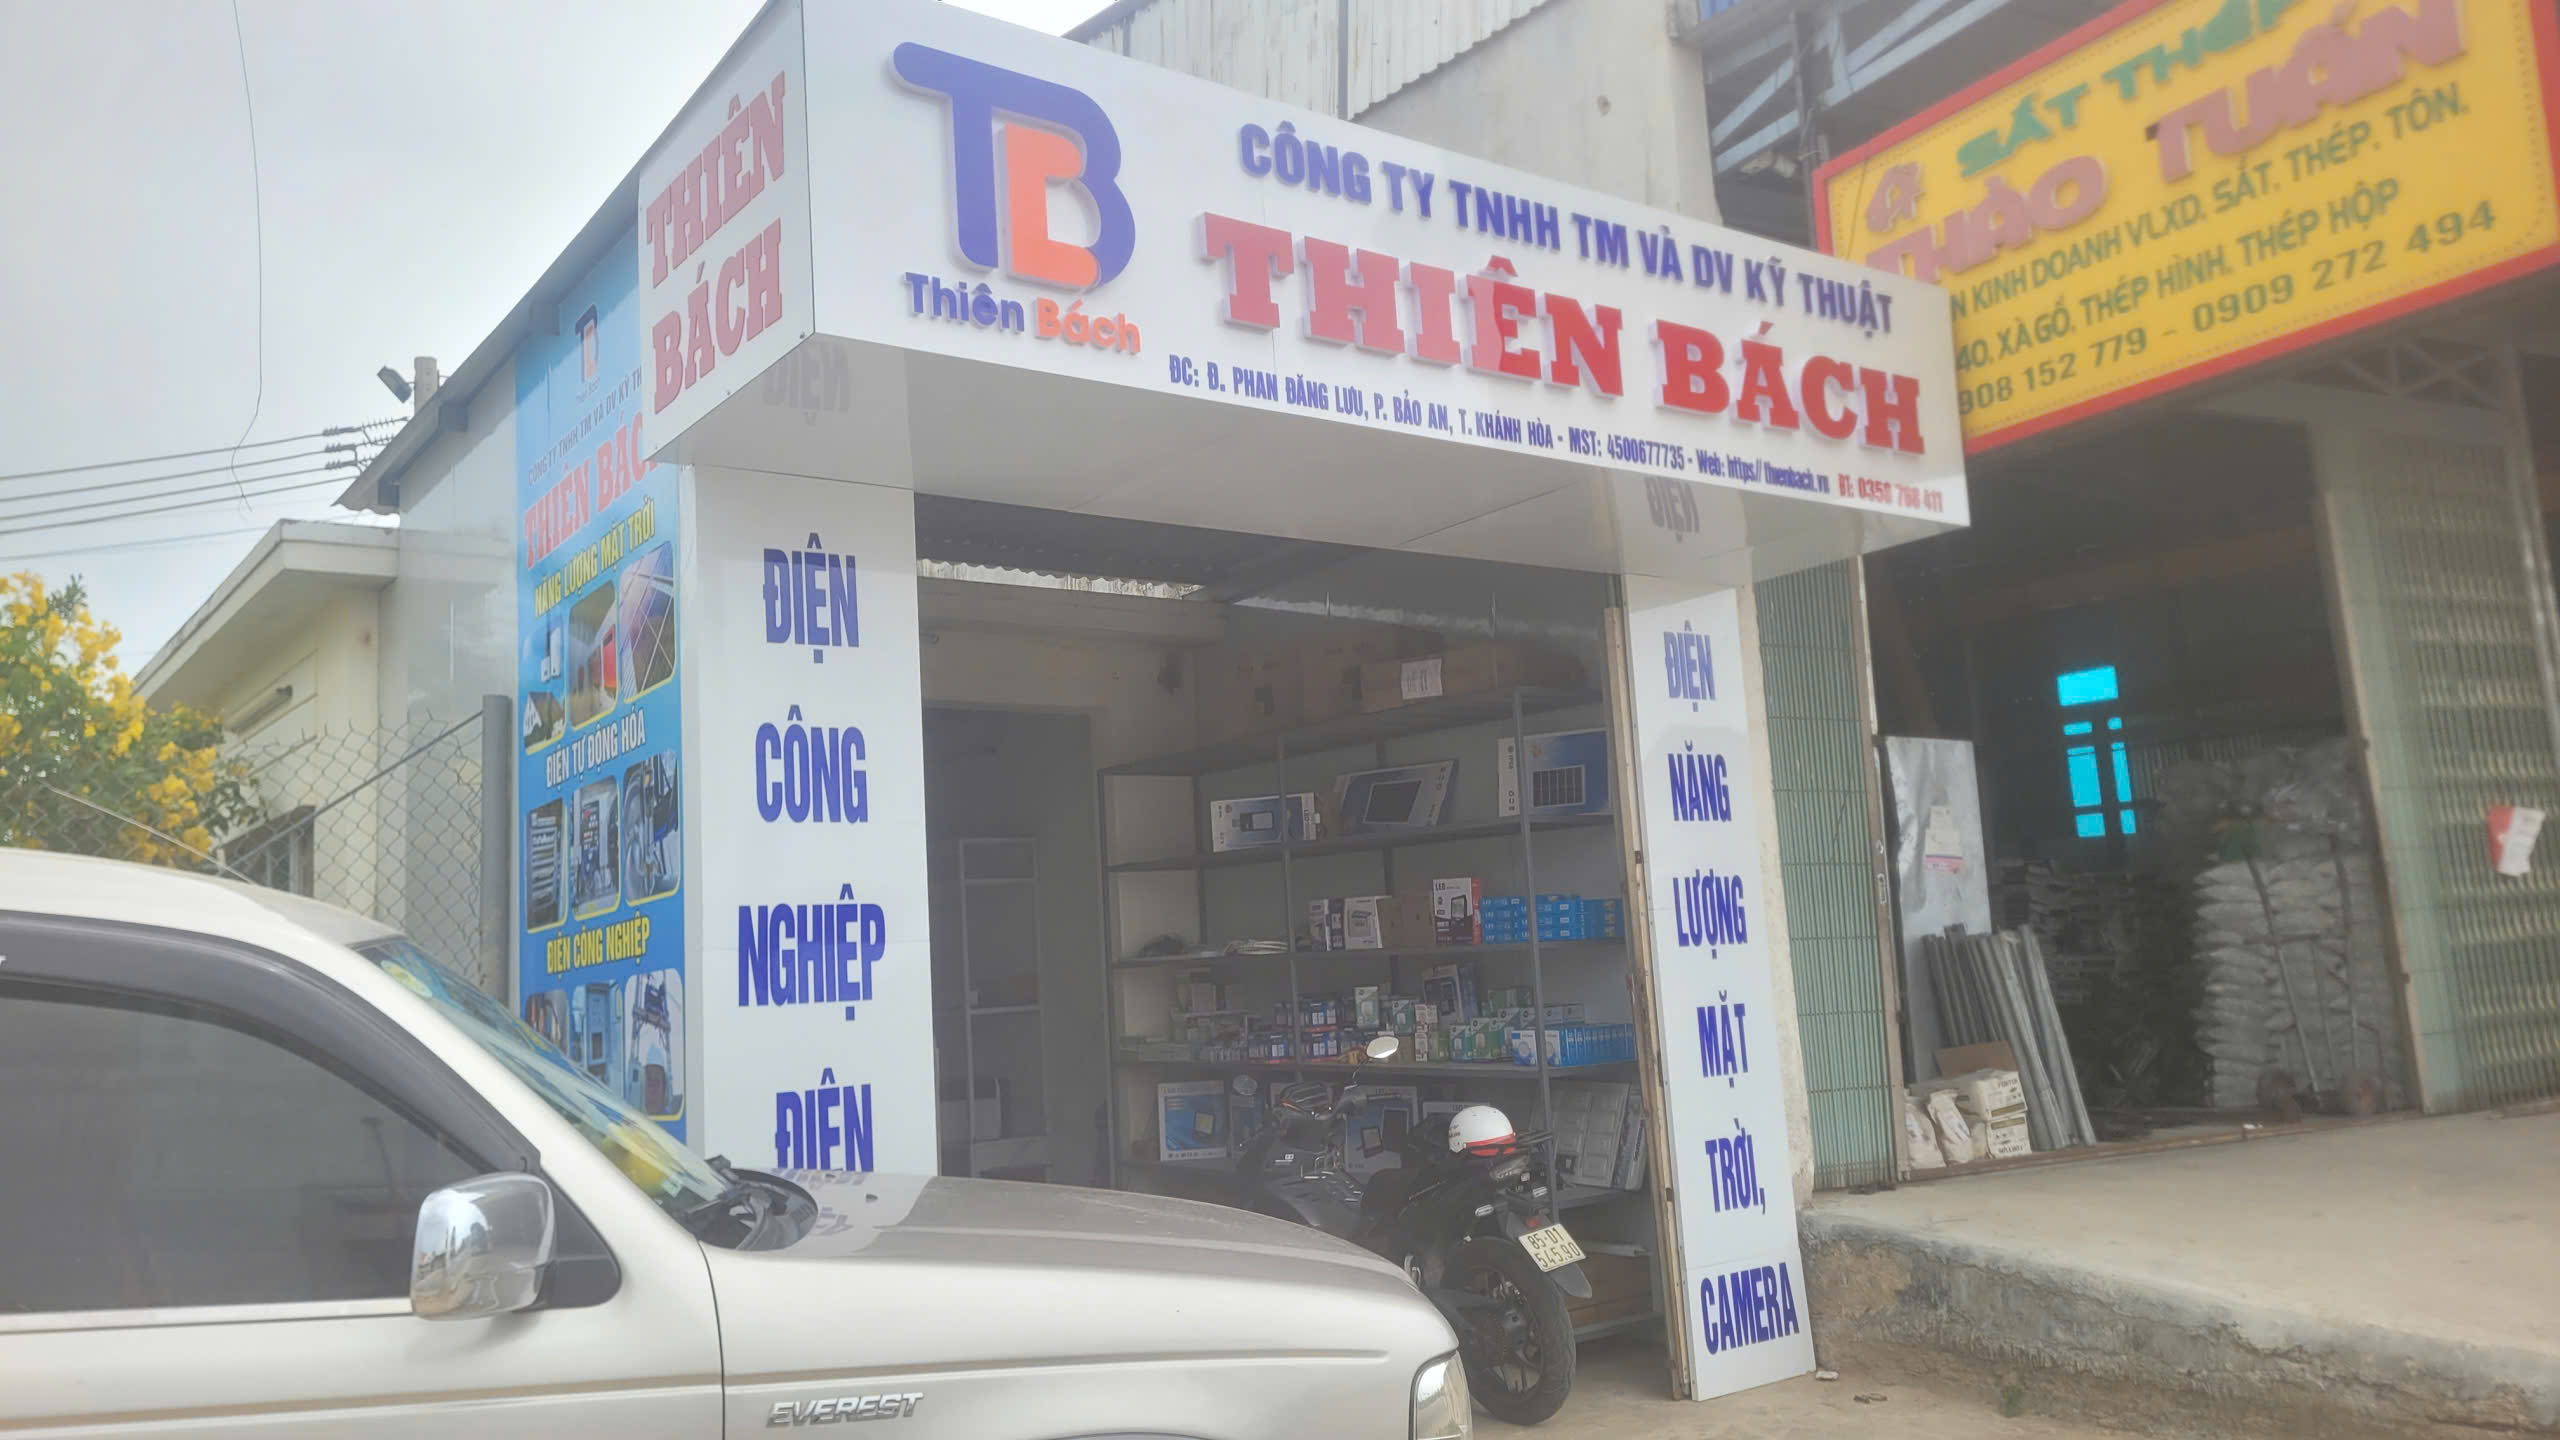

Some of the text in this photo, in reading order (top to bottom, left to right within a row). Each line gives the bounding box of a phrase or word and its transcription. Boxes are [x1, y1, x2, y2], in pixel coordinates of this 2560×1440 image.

[646, 70, 786, 288] THIÊN
[1240, 120, 1893, 339] CÔNG TY TNHH TM VÀ DV KỸ THUẬT
[652, 218, 783, 414] BÁCH
[903, 271, 1142, 355] Thiên Bách
[1970, 264, 2028, 314] KINH
[2031, 226, 2122, 289] DOANH
[2022, 351, 2078, 392] 152
[2089, 326, 2148, 369] 779
[2192, 271, 2295, 333] 0909
[2311, 239, 2388, 292] 272
[2407, 199, 2497, 254] 494
[1194, 212, 1926, 456] THIÊN BÁCH
[1169, 353, 1200, 388] ĐC:
[1207, 360, 1227, 393] Đ.
[1232, 365, 1280, 402] PHAN
[1285, 373, 1330, 411] ĐĂNG
[1373, 391, 1388, 421] P.
[1392, 388, 1423, 427] BẢO
[1427, 401, 1454, 437] AN,
[1458, 407, 1472, 436] T.
[1475, 409, 1522, 445] KHÁNH
[1526, 416, 1554, 450] HÒA
[1568, 425, 1602, 458] MST:
[1606, 433, 1685, 471] 4500677735
[1695, 447, 1726, 478] Web:
[523, 408, 658, 571] THIÊN BÁC
[534, 494, 656, 618] NĂNG LƯỢNG MẶT TRỜI
[763, 532, 860, 664] ĐIỆN
[1664, 622, 1717, 713] ĐIỆN
[546, 743, 571, 792] ĐIỆN
[587, 721, 620, 774] ĐỘNG
[620, 703, 647, 755] HÓA
[755, 704, 869, 824] CÔNG
[1668, 739, 1733, 822] NĂNG
[546, 908, 651, 982] ĐIỆN CÔNG NGHIỆP
[738, 883, 887, 1022] NGHIỆP
[1672, 868, 1748, 960] LƯỢNG
[1697, 991, 1750, 1089] MẶT
[1705, 1117, 1767, 1216] TRỜI,
[1700, 1261, 1800, 1356] CAMERA
[766, 1391, 925, 1428] EVEREST
